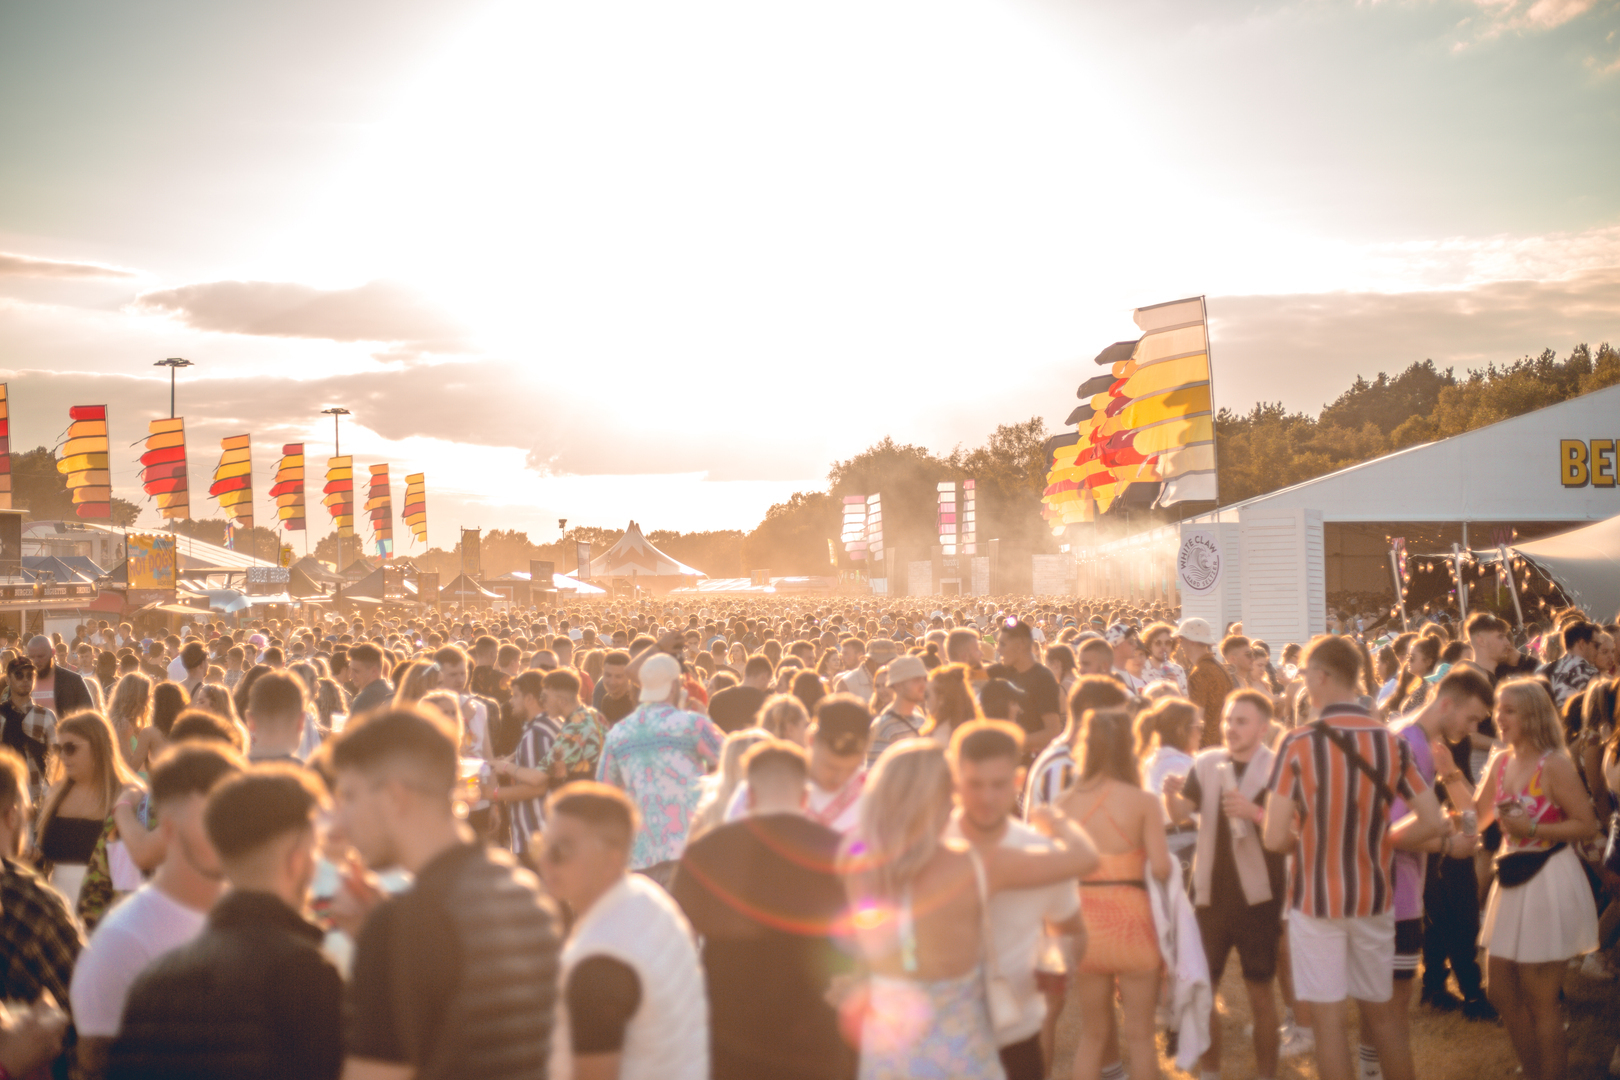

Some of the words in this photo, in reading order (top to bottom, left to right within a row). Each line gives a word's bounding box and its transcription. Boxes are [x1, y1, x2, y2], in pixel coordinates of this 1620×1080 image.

[1560, 439, 1620, 488] BE
[129, 556, 146, 577] HOT
[149, 549, 173, 573] DOGS
[1180, 538, 1194, 570] WHITE
[1194, 535, 1217, 553] CLAW
[1186, 575, 1200, 587] HARD
[1202, 561, 1217, 586] SELTZER
[14, 588, 34, 597] BURGERS
[44, 587, 67, 596] BAGUETTES
